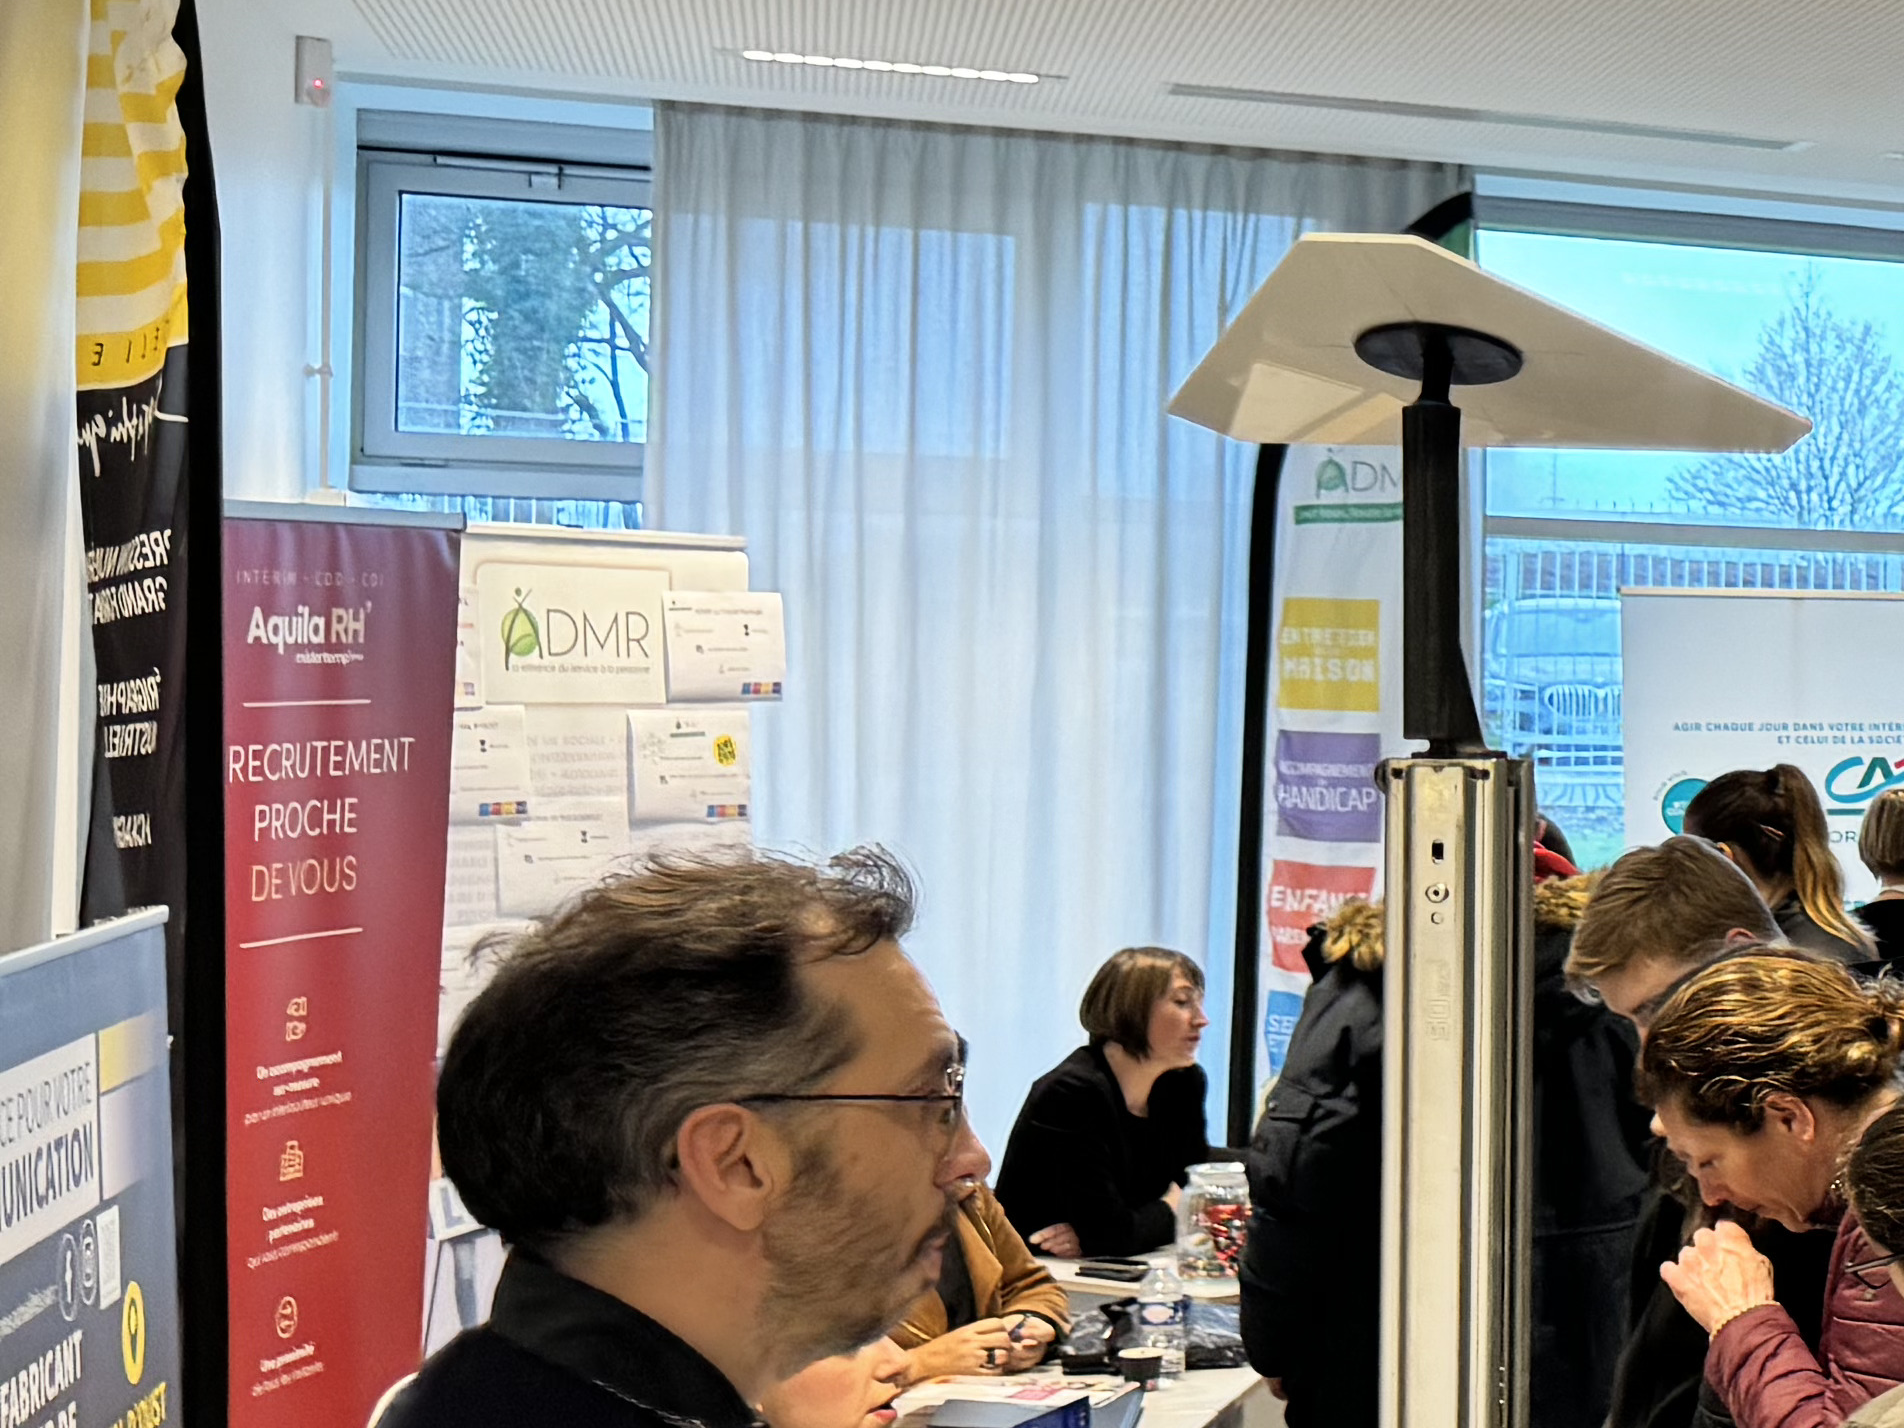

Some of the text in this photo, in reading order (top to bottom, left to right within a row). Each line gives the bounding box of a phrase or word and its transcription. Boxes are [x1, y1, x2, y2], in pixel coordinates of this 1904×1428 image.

[247, 604, 325, 655] Aquila
[501, 587, 649, 671] ADMR
[1283, 656, 1375, 682] MAISON
[1673, 721, 1702, 732] AGIR
[1706, 721, 1754, 732] CHAQUE
[1758, 721, 1789, 732] JOUR
[1794, 721, 1824, 732] DANS
[1828, 721, 1865, 732] VOTRE
[1777, 735, 1790, 745] ET
[1795, 735, 1828, 745] CELUI
[1832, 735, 1847, 745] DE
[1851, 735, 1865, 745] LA
[229, 737, 415, 783] RECRUTEMENT
[254, 797, 358, 842] PROCHE
[1278, 784, 1377, 812] HANDICAP
[252, 855, 357, 901] DE VOUS
[17, 1079, 53, 1135] POUR
[54, 1061, 92, 1119] VOTRE
[0, 1120, 94, 1231] UNICATION
